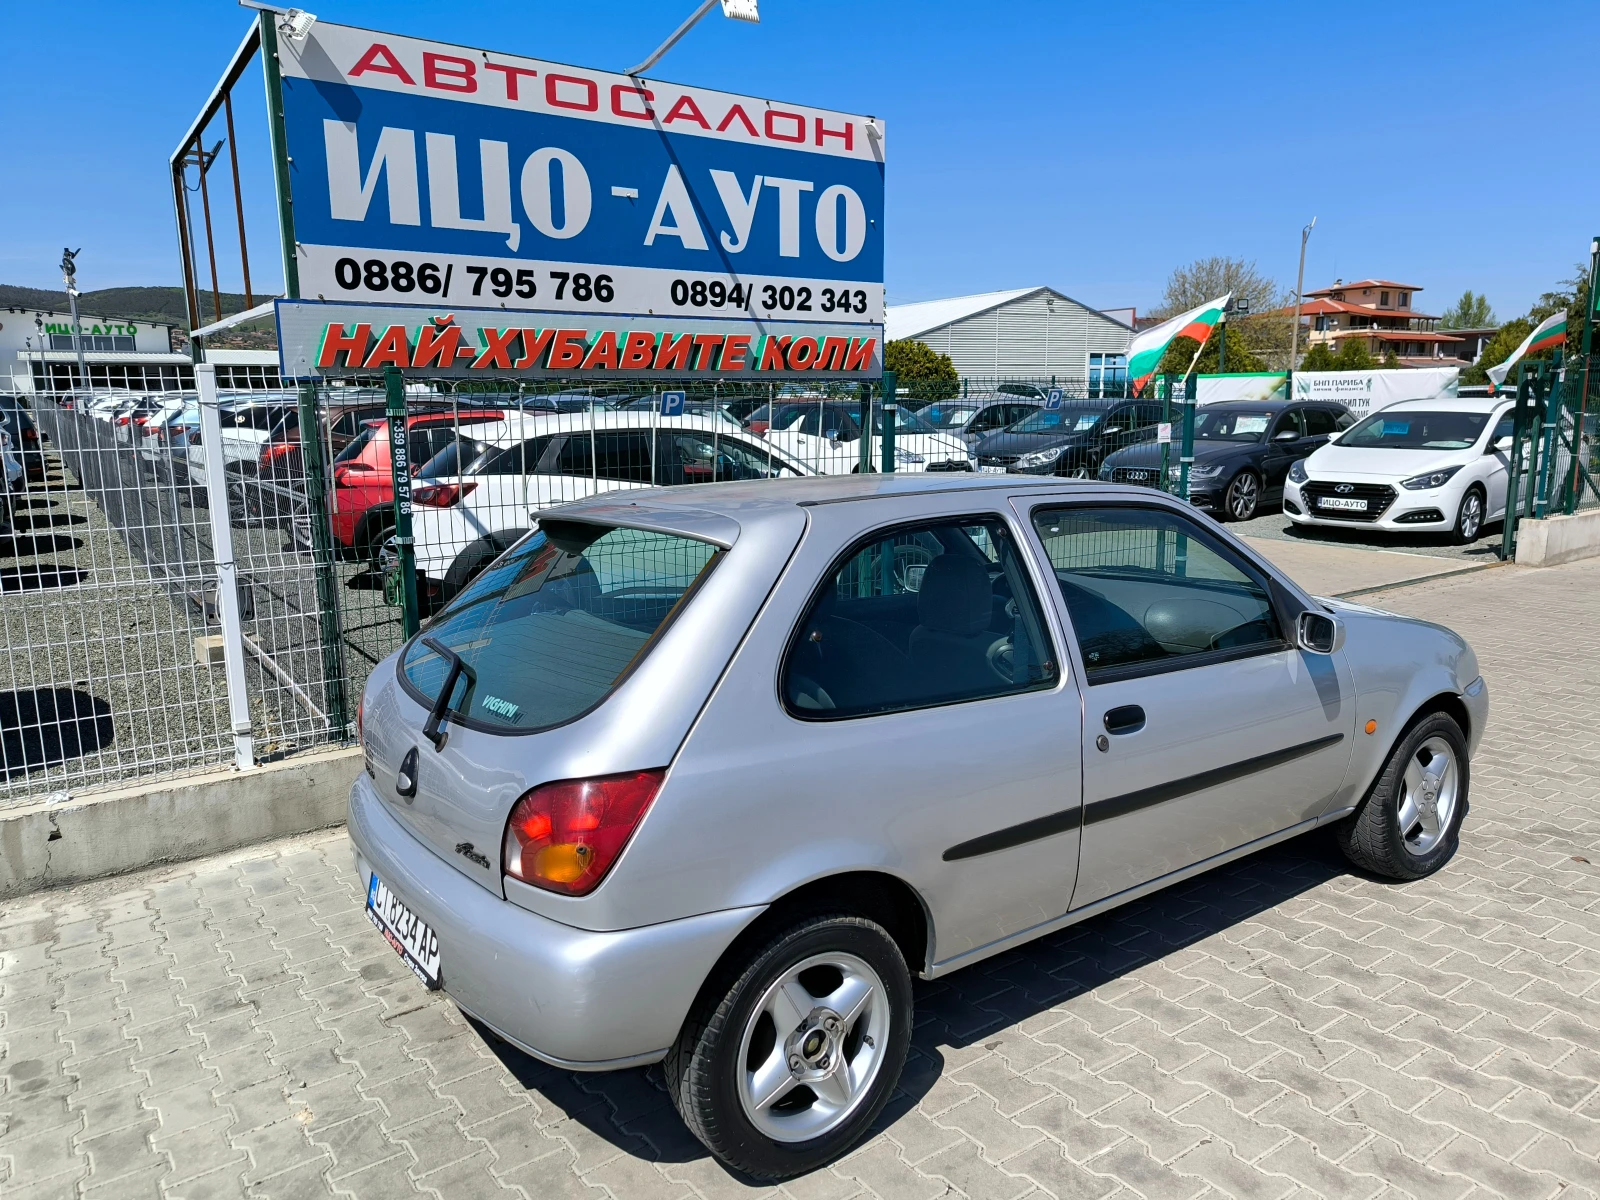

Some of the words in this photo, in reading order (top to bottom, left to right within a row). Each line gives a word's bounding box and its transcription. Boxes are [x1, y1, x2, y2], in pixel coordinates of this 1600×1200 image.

[348, 43, 853, 152] АВТОСАЛОН
[334, 257, 453, 299] 0886/
[466, 265, 537, 300] 795
[549, 270, 615, 304] 786
[670, 278, 754, 312] 0894/
[761, 284, 813, 313] 302
[820, 287, 868, 315] 343
[314, 312, 751, 371] НАЙ-ХУБАВИТЕ
[754, 333, 878, 372] КОЛИ
[665, 394, 679, 414] P
[394, 419, 405, 445] +359
[395, 448, 406, 467] 886
[397, 470, 408, 483] 79
[399, 486, 410, 498] 57
[401, 501, 411, 515] 86
[1323, 499, 1367, 508] ИЦО-АУТО
[482, 694, 518, 718] VIGHINI
